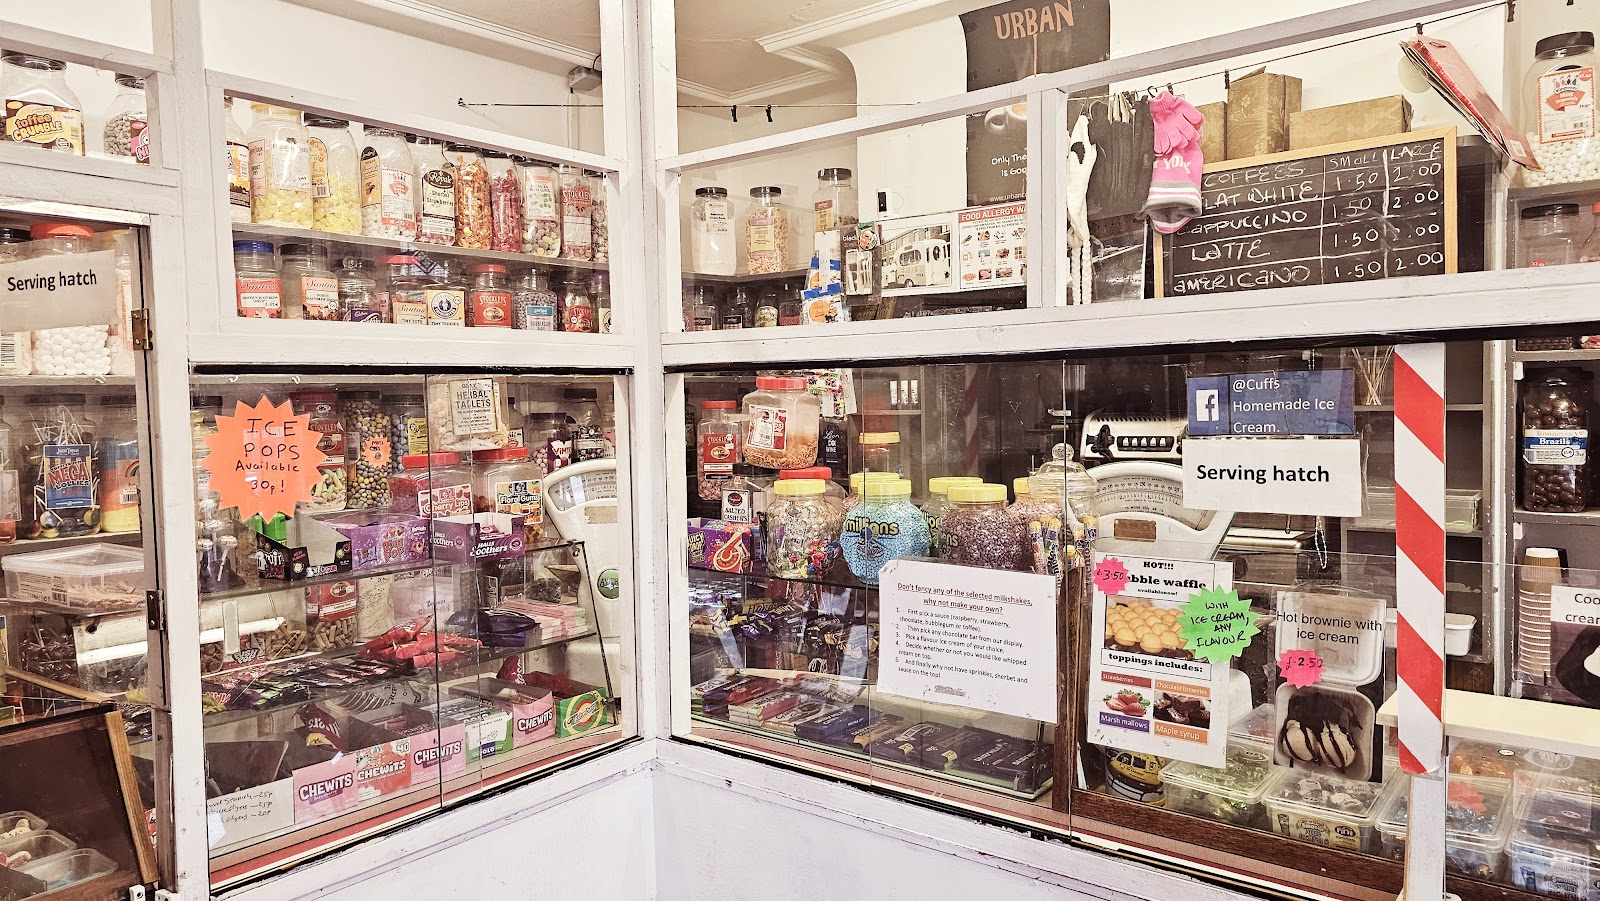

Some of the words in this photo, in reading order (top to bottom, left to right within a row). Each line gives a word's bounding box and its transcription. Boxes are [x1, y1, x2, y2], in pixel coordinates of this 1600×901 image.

[994, 0, 1075, 40] URBAN
[15, 113, 52, 128] toffee
[13, 121, 64, 142] CRUMBLE
[991, 154, 1010, 166] Only
[1204, 161, 1304, 188] COFFEES
[1391, 142, 1442, 160] LARGE
[1202, 192, 1241, 211] LAT
[1248, 181, 1318, 205] WHITE
[961, 213, 981, 222] FOOD
[982, 207, 1016, 219] ALLERGY
[1333, 228, 1379, 248] 1.50
[1335, 260, 1382, 279] 1.50
[1394, 252, 1444, 271] 2.00
[7, 272, 57, 291] Serving
[59, 268, 97, 288] hatch
[1232, 377, 1281, 392] @Cuffs
[456, 390, 489, 400] HERBAL
[455, 398, 491, 409] TABLETS
[1232, 397, 1311, 412] Homemade
[1315, 397, 1335, 410] Ice
[247, 417, 299, 438] ICE
[1233, 421, 1280, 433] Cream.
[1539, 437, 1571, 445] Brazils
[244, 442, 300, 460] POPS
[235, 459, 300, 473] Available
[48, 463, 90, 487] MEGA
[1196, 464, 1267, 485] Serving
[1273, 464, 1330, 483] hatch
[499, 494, 519, 504] Floral
[423, 502, 454, 514] Cherry
[469, 545, 508, 557] Soothers
[1143, 561, 1174, 570] HOT!!!
[1127, 575, 1160, 585] bble
[1163, 577, 1207, 590] waffle
[897, 582, 914, 590] Don't
[915, 585, 931, 594] fancy
[954, 589, 965, 597] the
[966, 591, 993, 600] selected
[994, 594, 1033, 606] milkshakes,
[923, 597, 937, 606] why
[950, 601, 968, 609] make
[969, 604, 984, 612] your
[985, 606, 1003, 614] own?
[899, 616, 924, 626] chocolate,
[925, 619, 954, 629] bubblegum
[980, 619, 1011, 629] strawberry,
[1191, 615, 1209, 625] ICE
[1213, 622, 1233, 633] ANY
[1276, 610, 1298, 623] Hot
[1301, 613, 1352, 629] brownie
[1355, 619, 1383, 632] with
[920, 627, 931, 635] pick
[942, 630, 969, 638] chocolate
[978, 634, 992, 642] from
[1003, 639, 1025, 648] display.
[1196, 630, 1247, 648] FLAVOUR
[1296, 627, 1315, 640] ice
[1318, 631, 1360, 645] cream
[920, 635, 939, 643] flavour
[985, 645, 1005, 654] choice.
[905, 641, 922, 650] Decide
[923, 645, 945, 653] whether
[974, 652, 991, 660] would
[991, 654, 1002, 662] like
[1002, 657, 1027, 666] whipped
[1108, 652, 1153, 666] toppings
[1154, 658, 1203, 673] includes:
[915, 660, 932, 668] finally
[954, 665, 968, 673] have
[968, 669, 994, 679] sprinkles,
[994, 673, 1016, 682] sherbet
[1016, 676, 1028, 684] and
[1102, 672, 1134, 684] Strawberries
[1156, 681, 1182, 691] Chocolate
[1182, 685, 1208, 696] brownies
[1101, 714, 1120, 724] Marsh
[1121, 717, 1148, 729] mallows
[1155, 724, 1179, 736] Maple
[1179, 729, 1200, 741] syrup
